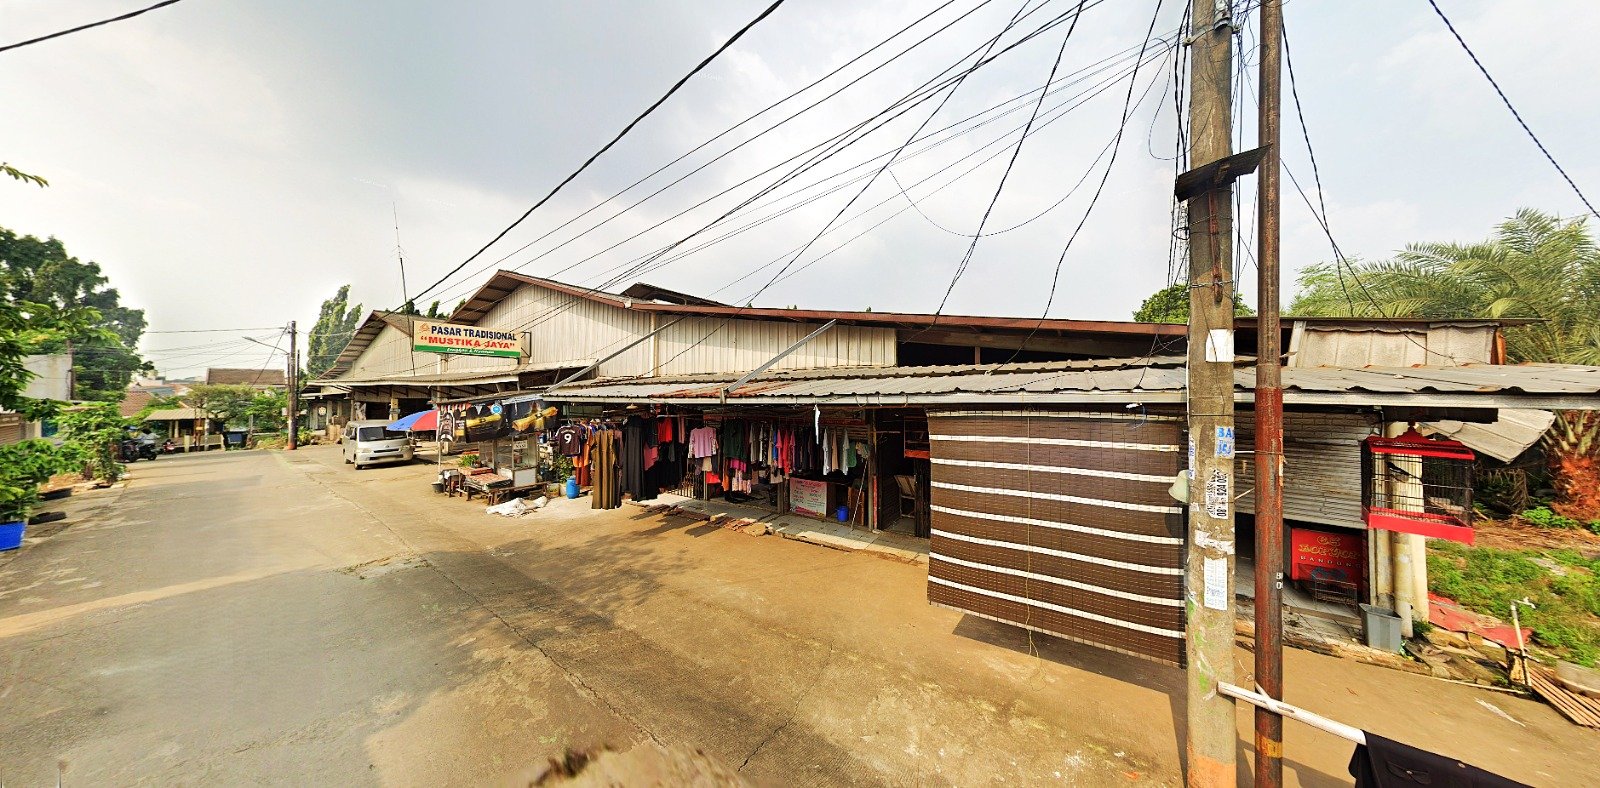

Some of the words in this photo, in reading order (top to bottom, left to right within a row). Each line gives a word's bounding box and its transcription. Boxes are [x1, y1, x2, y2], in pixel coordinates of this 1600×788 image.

[431, 326, 462, 336] PASAR
[463, 328, 517, 341] TRADISIONAL
[564, 434, 572, 444] 9
